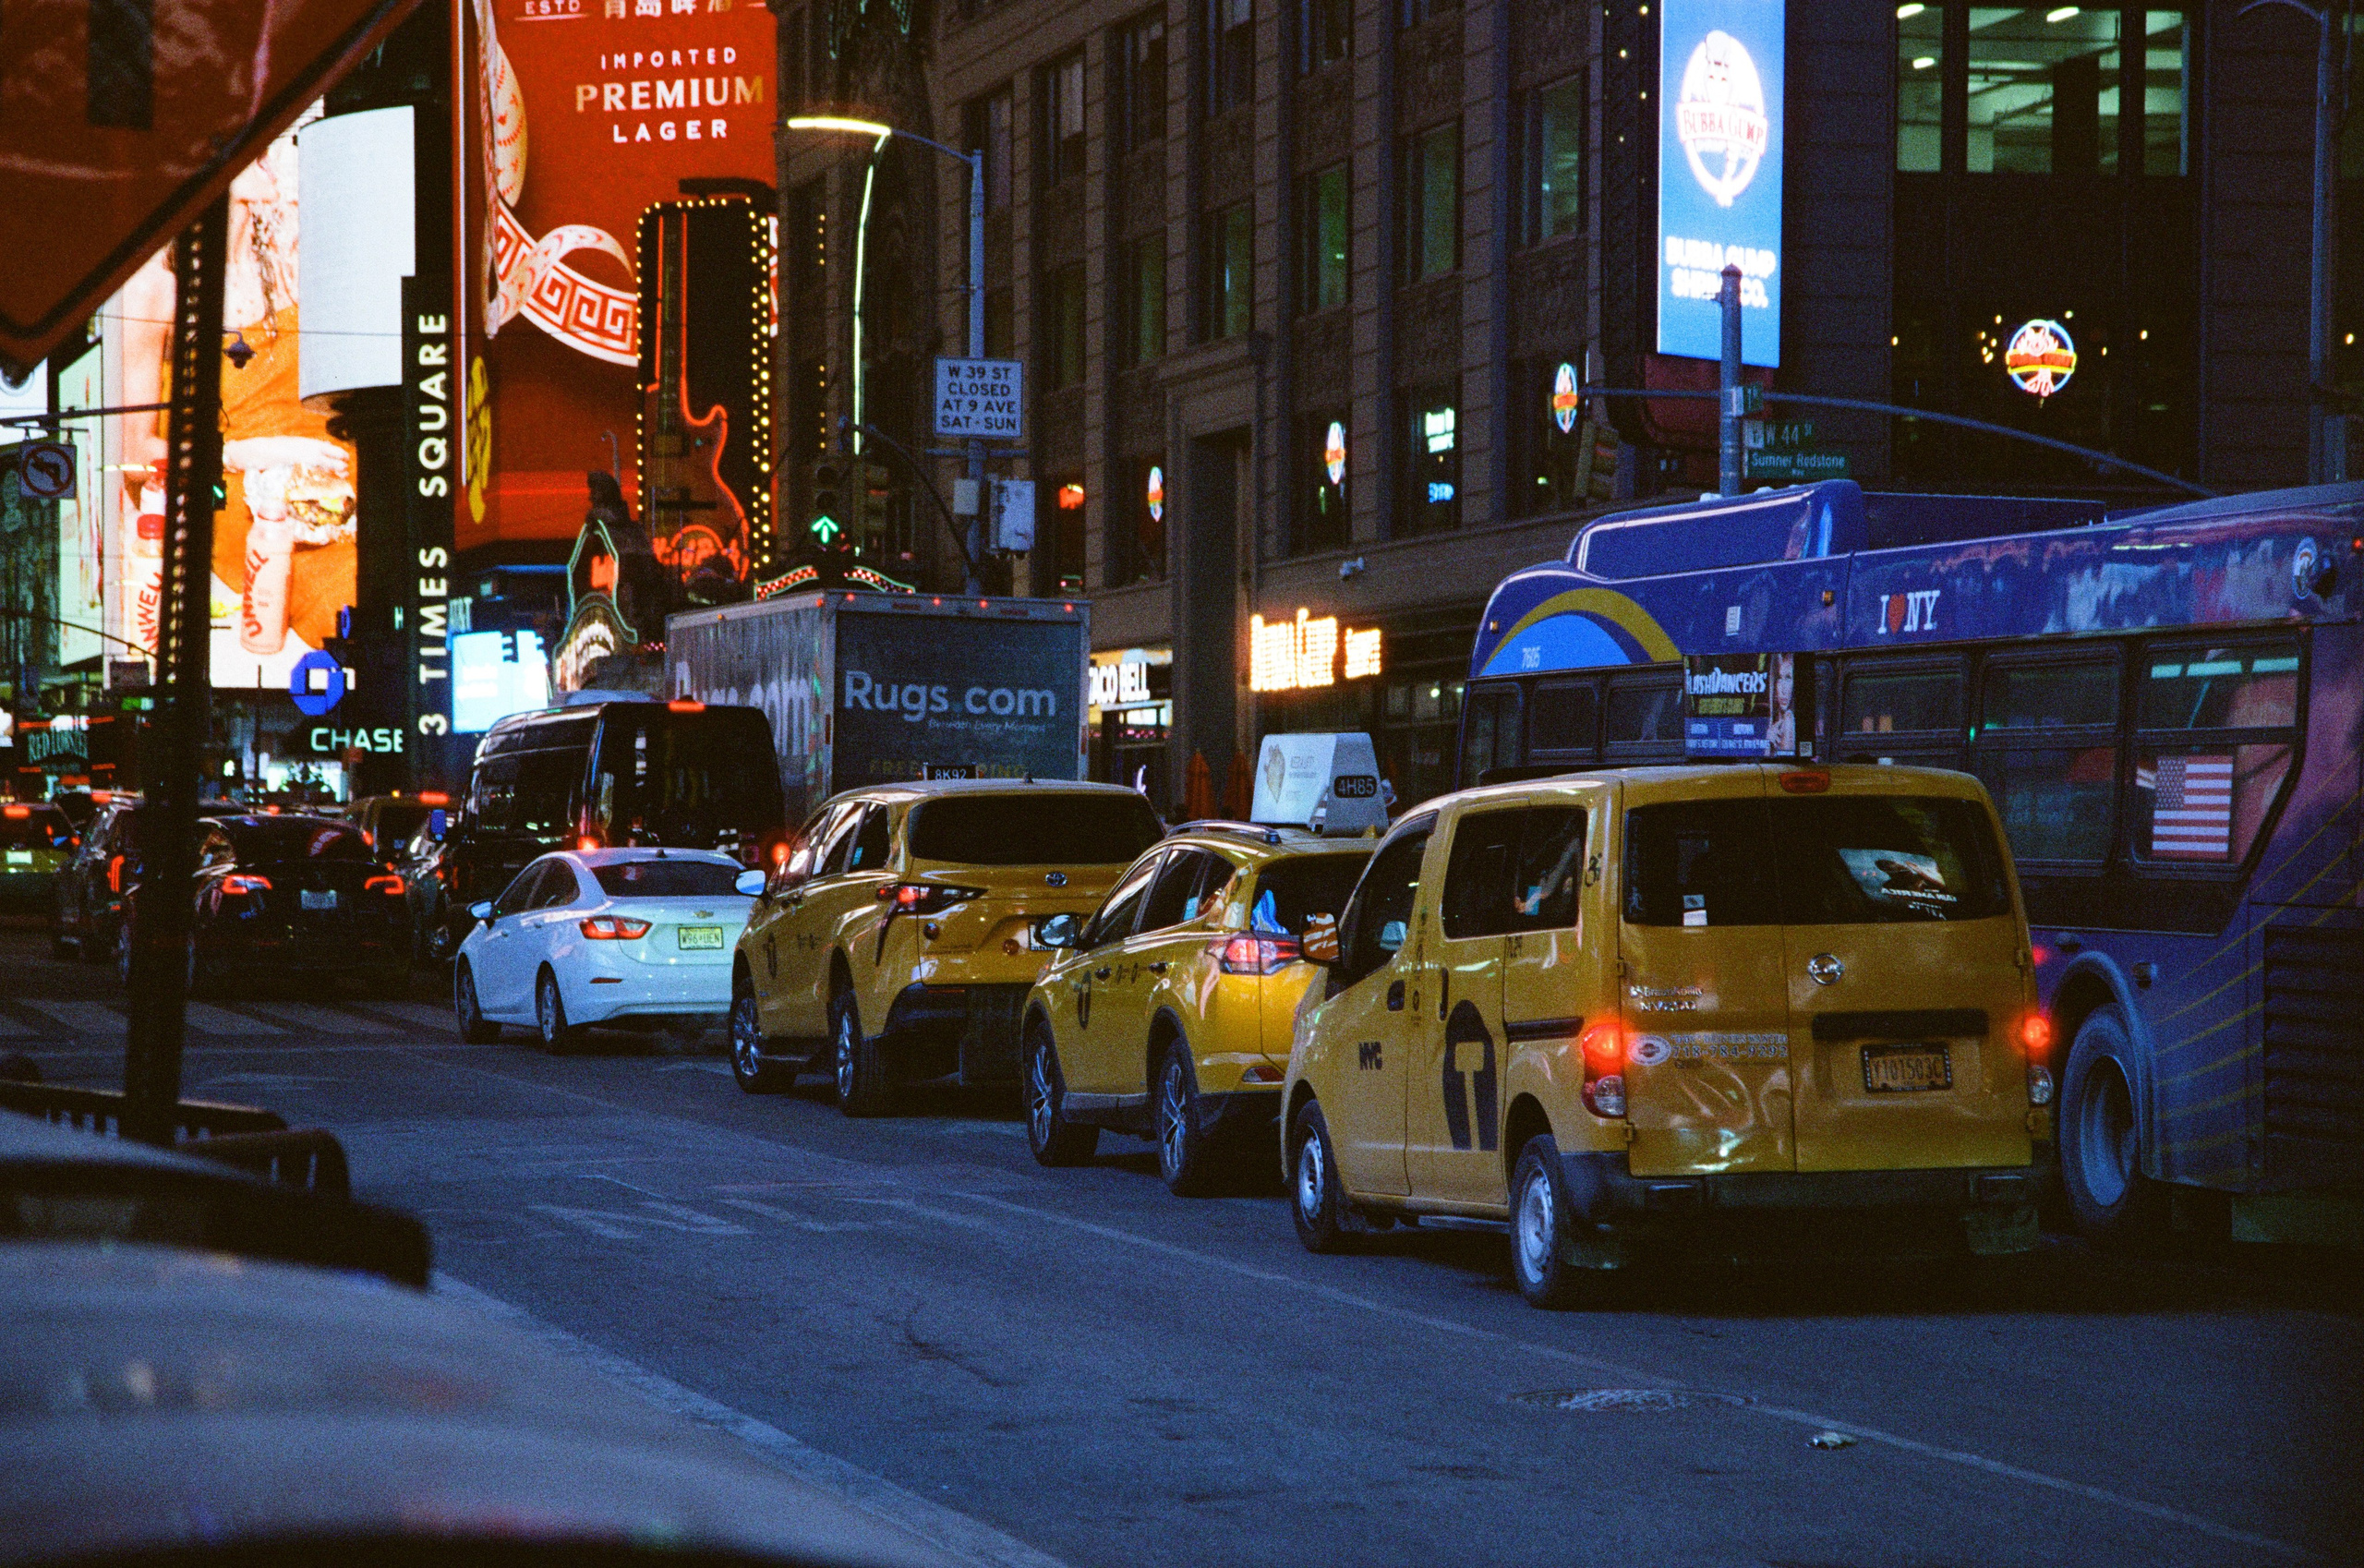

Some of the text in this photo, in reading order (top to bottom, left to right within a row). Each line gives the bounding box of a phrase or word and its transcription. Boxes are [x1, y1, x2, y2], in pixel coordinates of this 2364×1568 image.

[601, 47, 736, 69] IMPORTED
[575, 76, 763, 113] PREMIUM
[613, 119, 727, 143] LAGER
[948, 366, 1010, 380] W 39 ST
[947, 382, 1010, 396] CLOSED
[942, 399, 1016, 414] AT 9 AVE
[1781, 425, 1798, 444] 44
[1752, 452, 1845, 468] Sumner Redstone
[418, 315, 448, 736] 3 TIMES SQUARE
[1877, 590, 1940, 634] I NY
[1089, 661, 1150, 705] TACO BELL
[844, 669, 1055, 722] Rugs.com
[311, 728, 404, 753] CHASE
[935, 768, 967, 779] 8K92
[1338, 779, 1374, 795] 4H85
